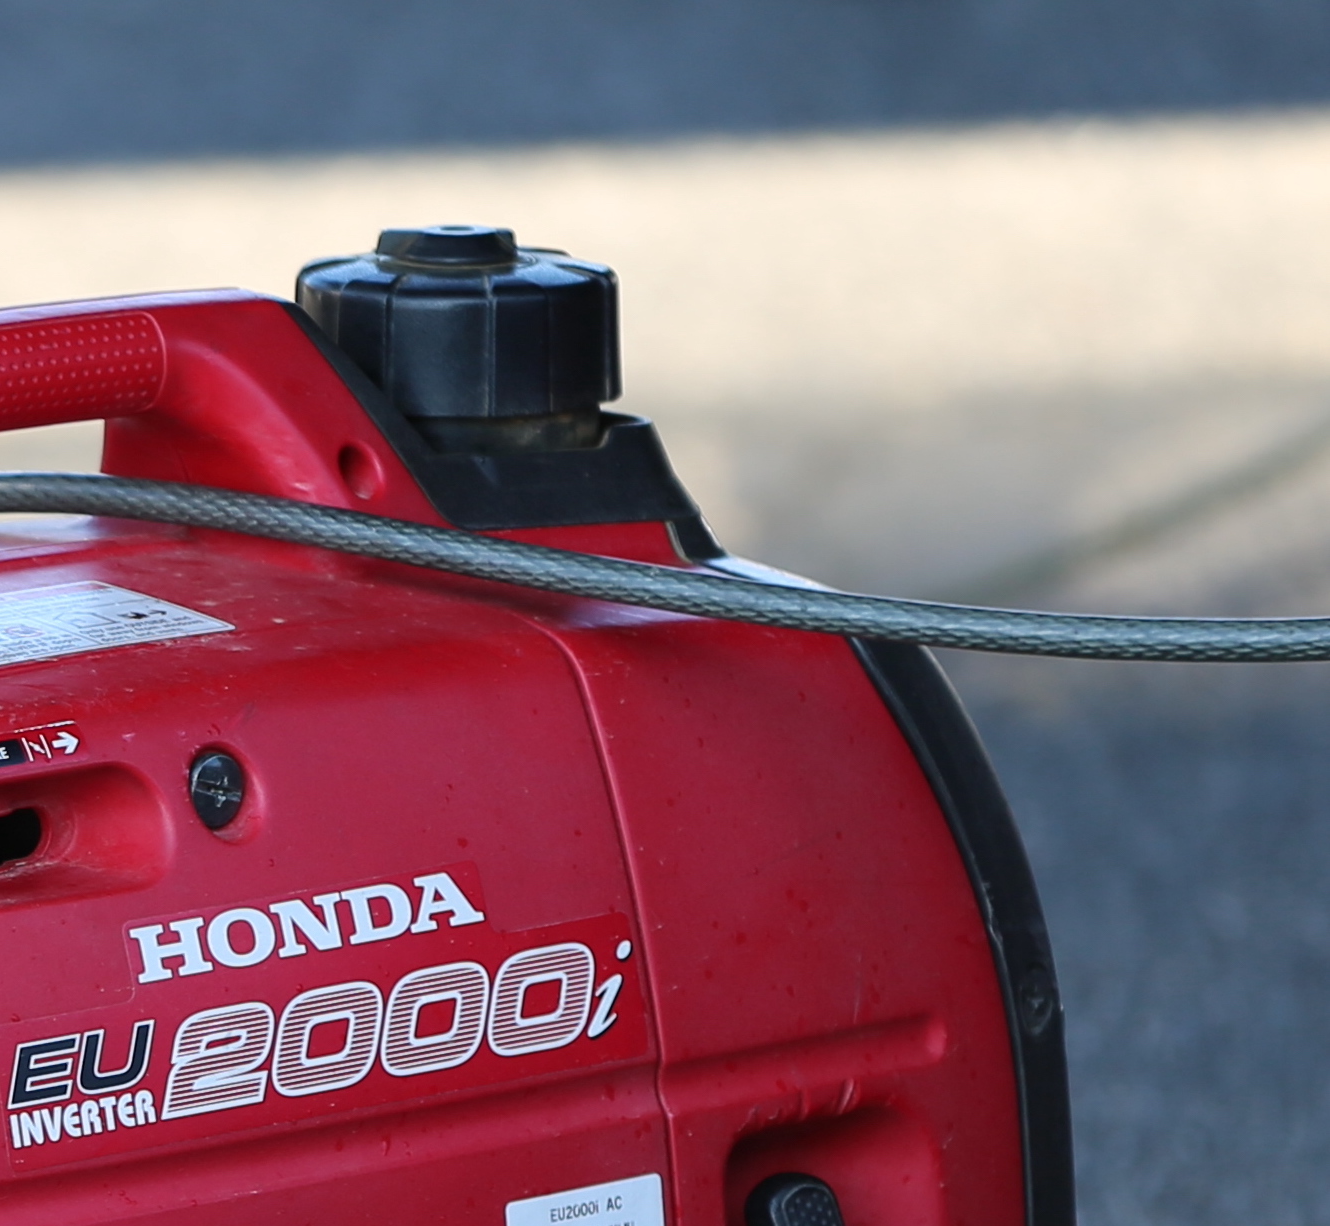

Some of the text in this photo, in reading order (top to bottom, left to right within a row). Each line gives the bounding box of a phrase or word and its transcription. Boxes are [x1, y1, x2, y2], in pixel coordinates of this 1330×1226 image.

[129, 872, 484, 984] HONDA
[9, 1088, 157, 1149] INVERTER
[550, 1196, 623, 1223] EU2000i AC
